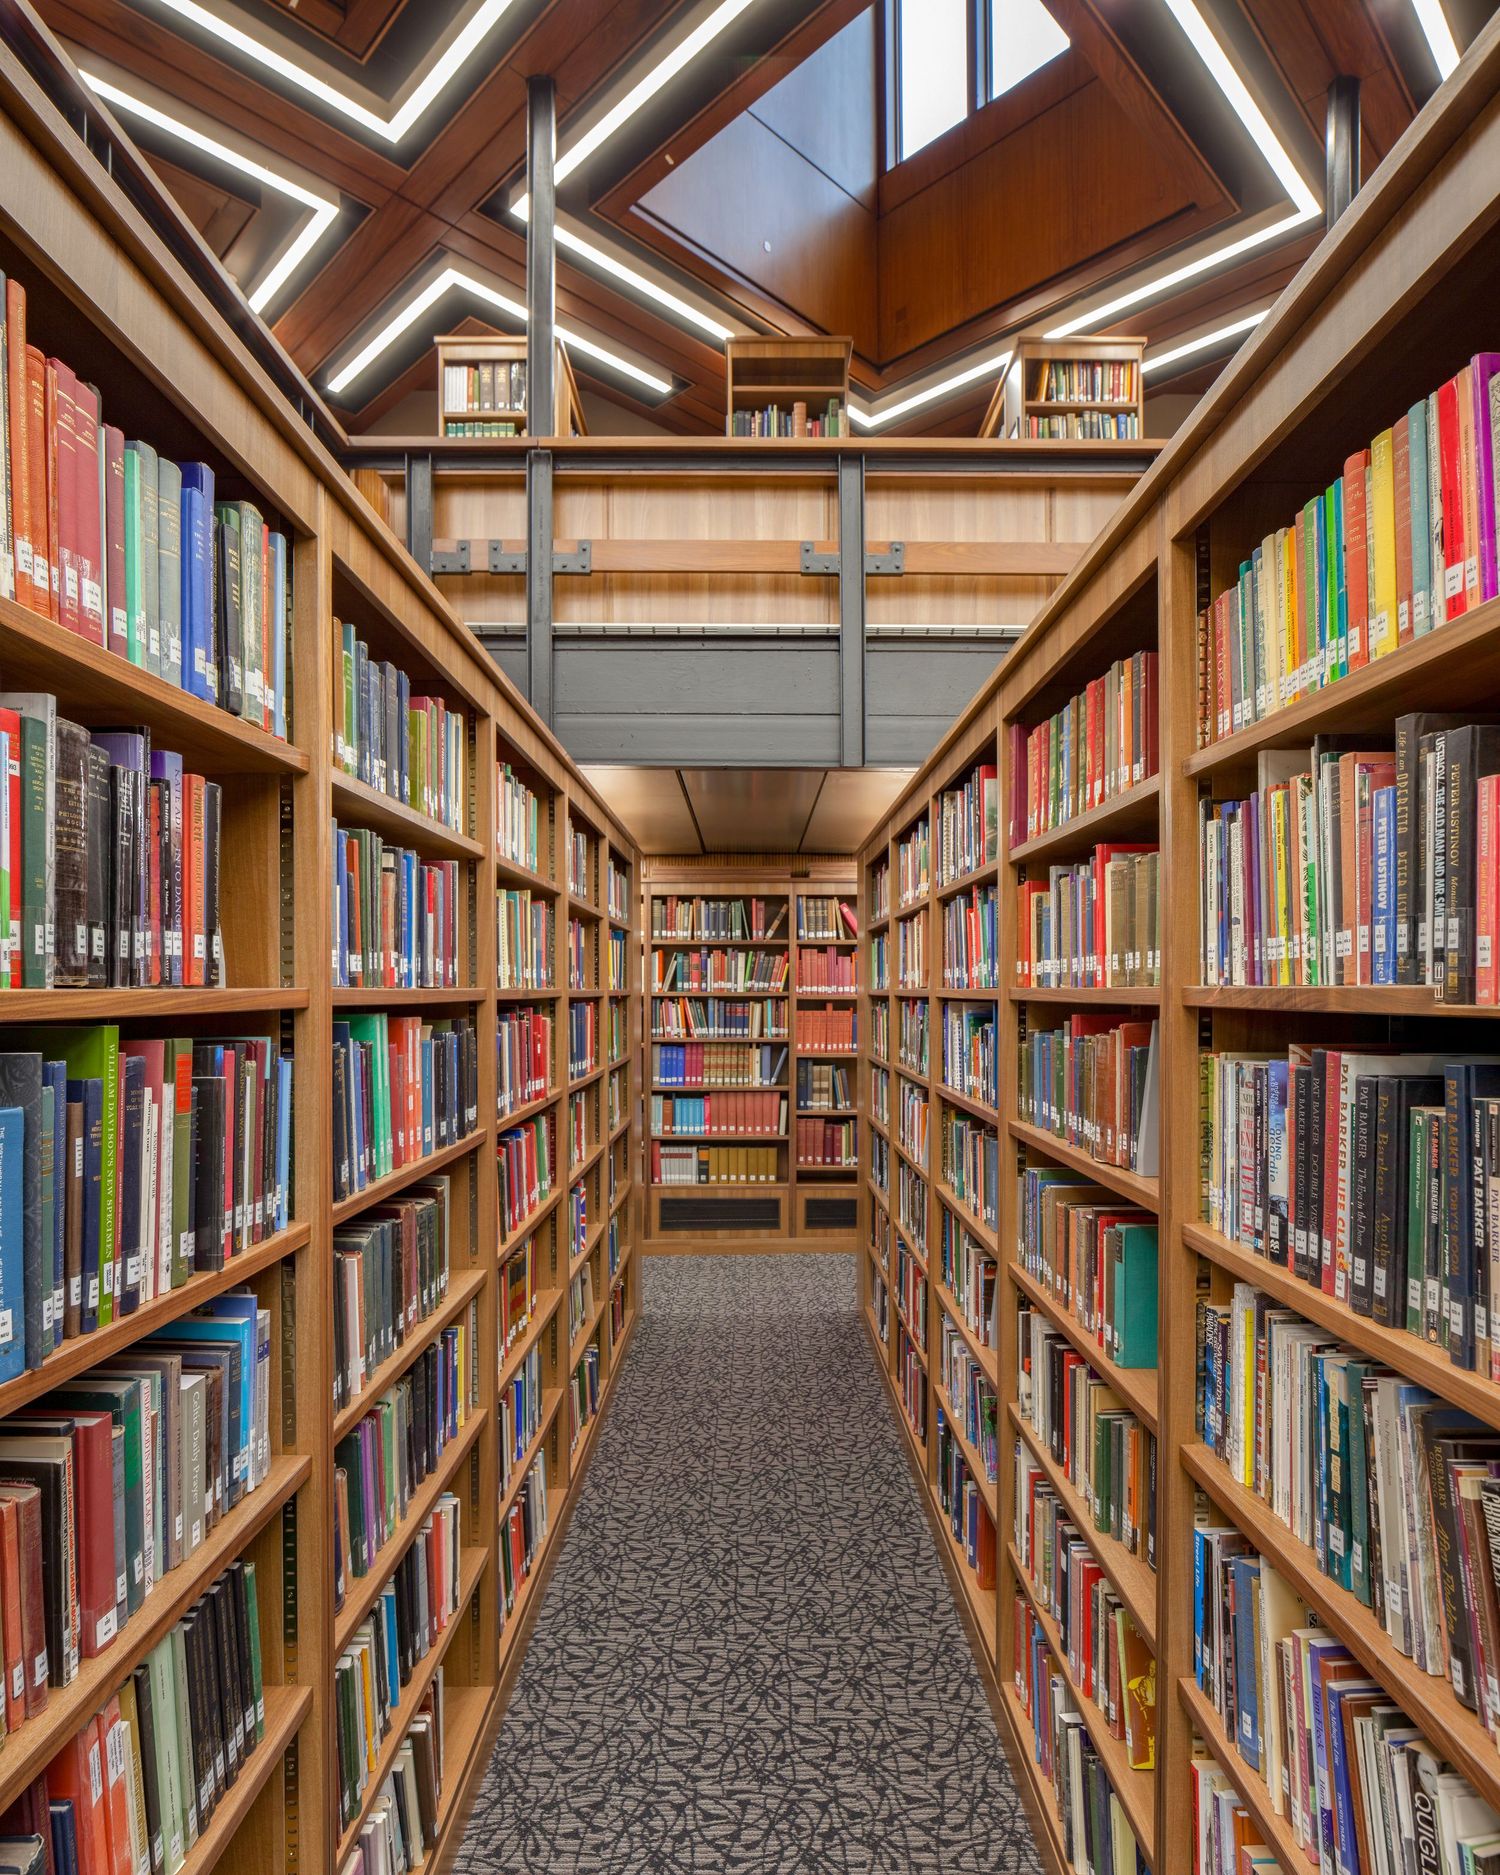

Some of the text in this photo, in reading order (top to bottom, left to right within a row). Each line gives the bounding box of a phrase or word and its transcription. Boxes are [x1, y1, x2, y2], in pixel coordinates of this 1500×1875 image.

[1398, 731, 1407, 747] Life
[1399, 761, 1406, 770] an
[1436, 738, 1444, 779] USTINOV
[1436, 787, 1444, 802] THE
[1452, 764, 1460, 806] PETER
[1481, 780, 1489, 812] PETER
[1397, 773, 1409, 834] OPERETTA
[1435, 805, 1444, 829] OLD
[174, 769, 182, 932] KATE ADIE INTO DANGE
[1435, 830, 1444, 852] MAN
[1451, 810, 1459, 866] USTINOV
[1377, 818, 1387, 909] PETER USTINOV
[1397, 852, 1408, 886] PETER
[1435, 856, 1444, 877] AND
[1312, 1078, 1320, 1097] PAT
[1360, 1084, 1369, 1106] PAT
[239, 1100, 245, 1114] ON
[1377, 1095, 1389, 1123] Pat
[1298, 1140, 1306, 1159] THE
[1359, 1110, 1368, 1157] BARKER
[1337, 1063, 1349, 1271] PAT BARKER LIFE CLASS
[1377, 1133, 1388, 1194] Barker
[1431, 1137, 1439, 1169] BARKER
[106, 1169, 114, 1194] NEW
[1298, 1162, 1306, 1198] GHOST
[1358, 1168, 1367, 1180] The
[1446, 1080, 1459, 1276] PAT BARKER TOBY'S ROOM
[1473, 1156, 1483, 1185] PAT
[1356, 1184, 1367, 1201] Eye
[1431, 1177, 1439, 1225] REGENERATION
[105, 1196, 113, 1259] SPECIMEN
[1297, 1200, 1305, 1227] ROAD
[1357, 1211, 1366, 1224] the
[1473, 1188, 1484, 1247] BARKER
[1491, 1189, 1500, 1264] PAT BARKER
[1357, 1226, 1366, 1246] Door
[1205, 1312, 1214, 1346] PARADISE
[1215, 1342, 1223, 1411] SAMARITAN
[190, 1392, 202, 1504] Celtic Daily Prayer
[1429, 1452, 1439, 1498] GORING
[1434, 1445, 1447, 1508] ROSEMARY
[1436, 1520, 1458, 1634] After Flodden
[1313, 1691, 1331, 1855] Tom Fleck Harry Nicholso
